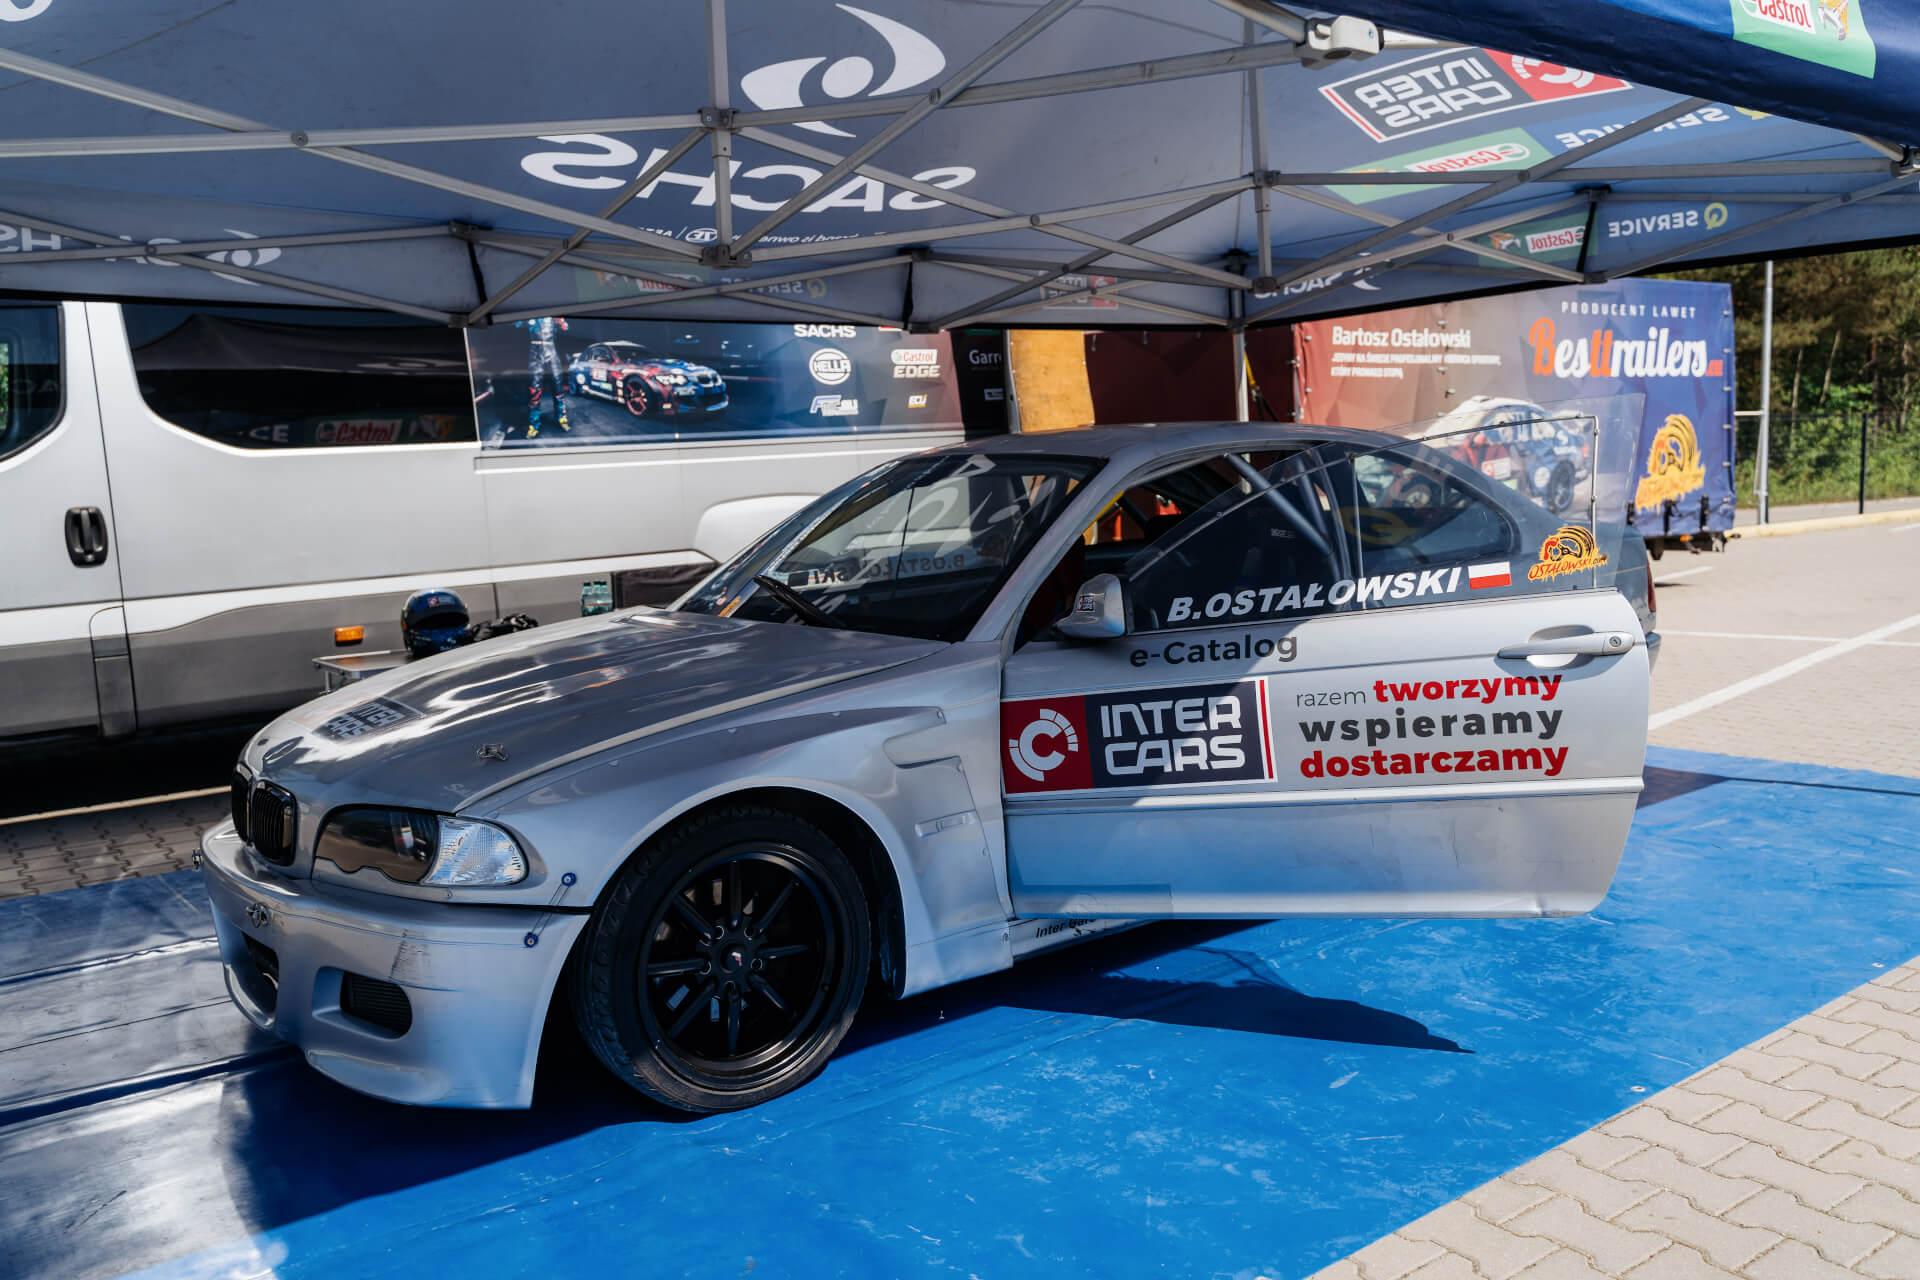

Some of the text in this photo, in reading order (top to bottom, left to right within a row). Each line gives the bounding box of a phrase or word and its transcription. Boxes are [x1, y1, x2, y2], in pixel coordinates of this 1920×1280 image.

[1561, 302, 1696, 318] PRODUCENT LAWET
[793, 324, 857, 338] SACHS
[1332, 326, 1389, 346] Bartosz
[893, 365, 941, 378] EDGE
[903, 351, 933, 362] Castrol
[969, 349, 1002, 365] Garr
[1167, 566, 1461, 622] B.OSTAŁOWSKI
[1129, 634, 1298, 668] e-Catalog
[1296, 674, 1562, 709] razem tworzymy
[1101, 694, 1242, 739] INTER
[1298, 708, 1564, 747] wspieramy
[1104, 735, 1246, 775] CARS
[1300, 745, 1569, 779] dostarczamy
